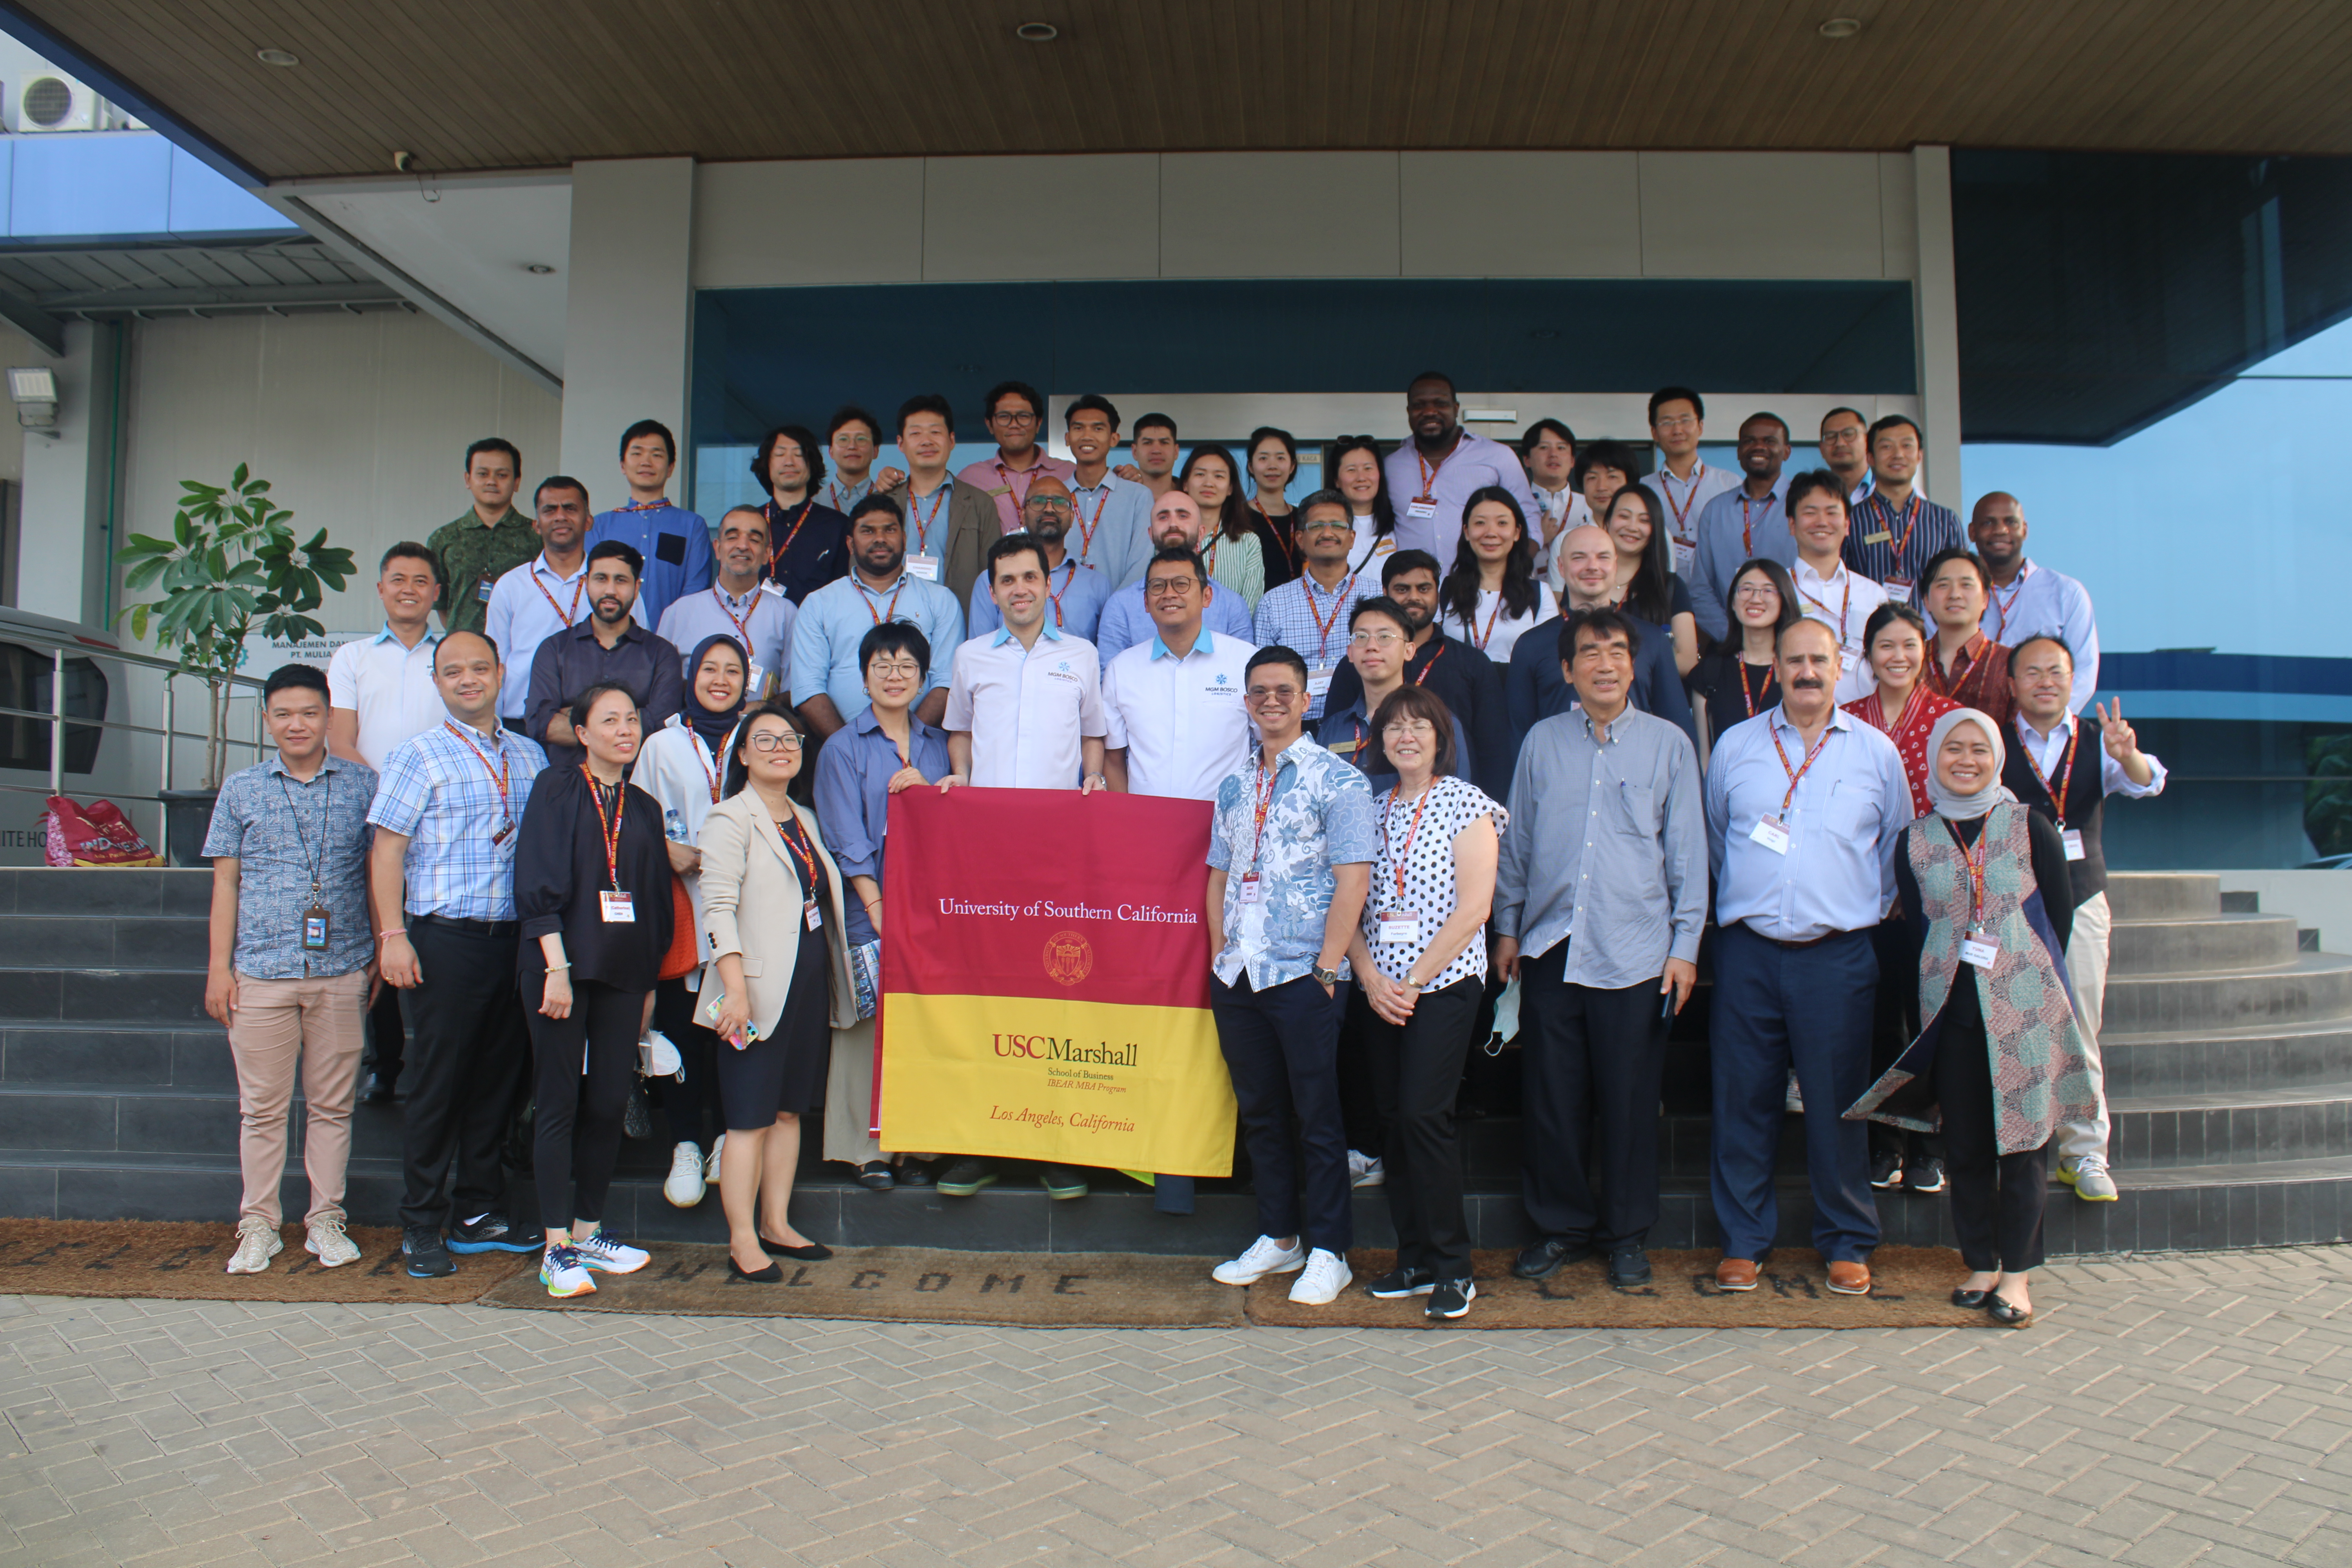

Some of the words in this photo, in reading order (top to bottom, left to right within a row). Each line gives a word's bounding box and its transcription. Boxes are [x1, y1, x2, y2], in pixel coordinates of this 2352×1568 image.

[1062, 673, 1078, 682] BOSCO
[590, 782, 602, 804] USCMarshall
[1261, 786, 1272, 813] USCMarshall
[0, 830, 25, 847] ITE
[613, 817, 622, 839] USCMarshall
[1407, 816, 1420, 842] USCMarshall
[1768, 830, 1780, 839] CARL
[938, 898, 1020, 921] University
[1024, 900, 1042, 916] of
[1044, 900, 1112, 920] Southern
[1117, 904, 1198, 924] California
[1047, 1067, 1072, 1078] School
[1073, 1069, 1082, 1078] of
[1083, 1070, 1114, 1080] Business
[1047, 1078, 1074, 1089] IBEAR
[1075, 1081, 1096, 1091] MBA
[1097, 1083, 1127, 1095] Program
[989, 1105, 1014, 1120] Los
[1014, 1107, 1065, 1129] Angeles,
[1069, 1112, 1135, 1134] California
[654, 1261, 1091, 1296] WLCOME
